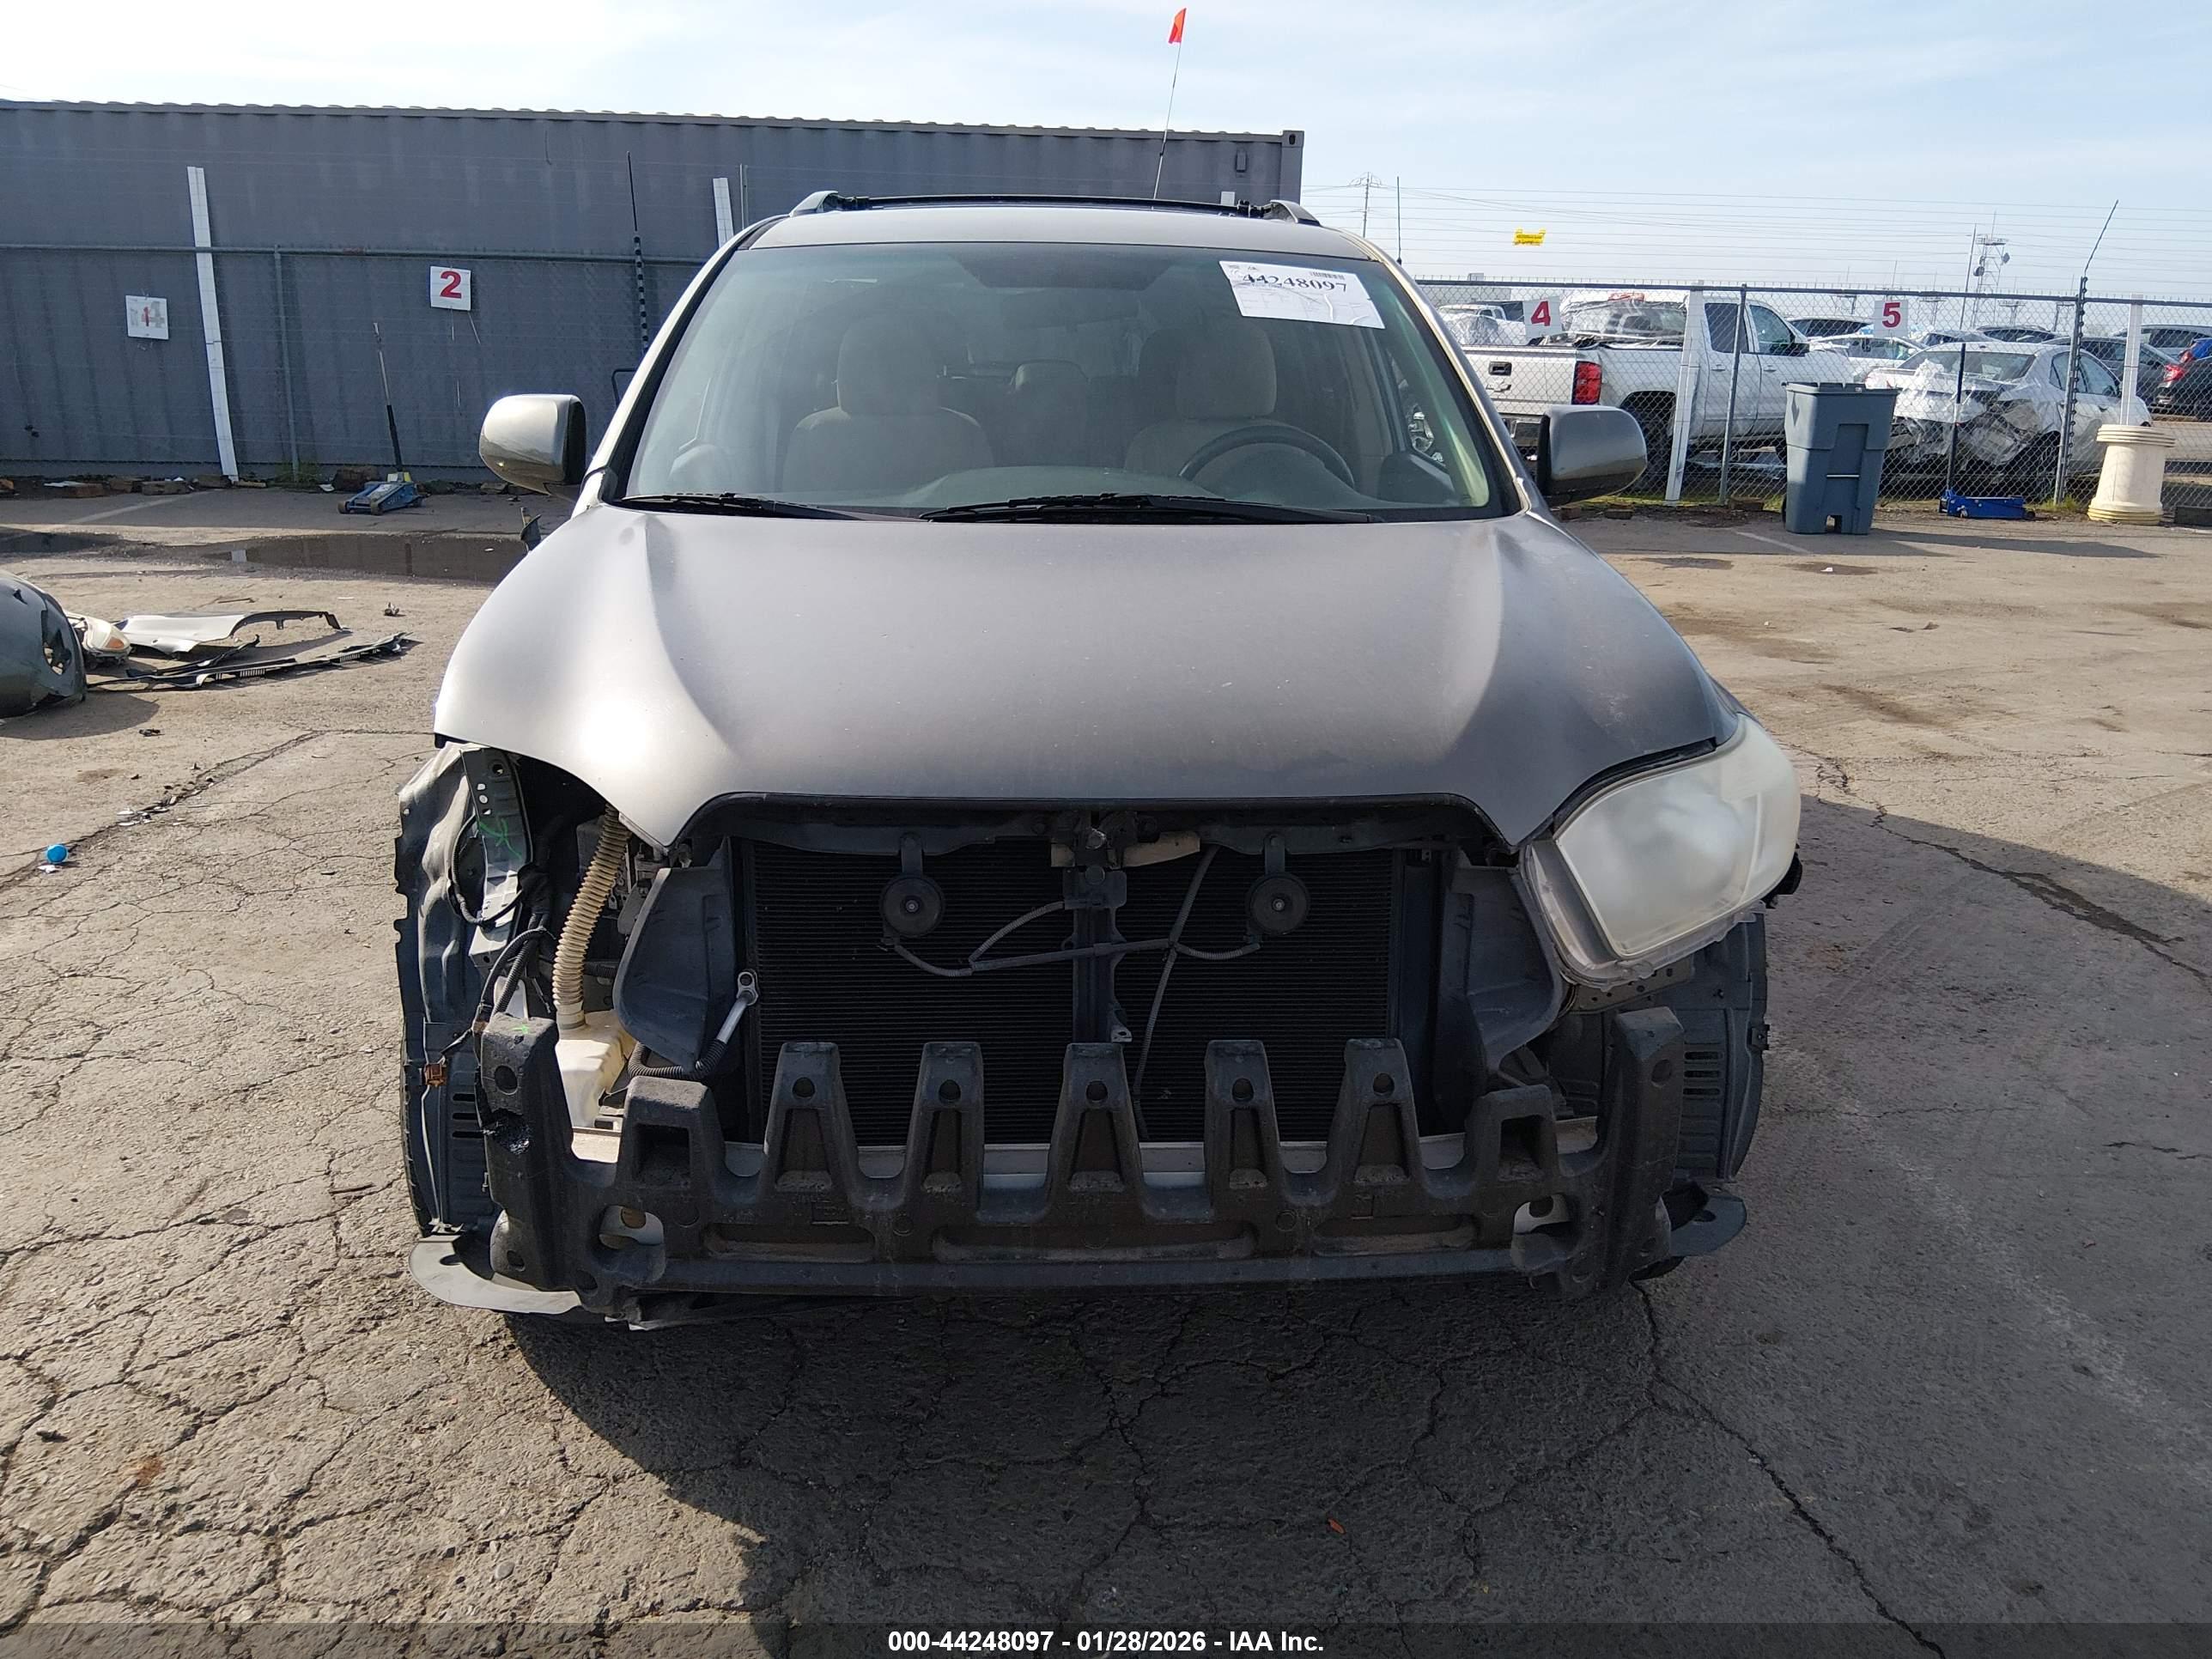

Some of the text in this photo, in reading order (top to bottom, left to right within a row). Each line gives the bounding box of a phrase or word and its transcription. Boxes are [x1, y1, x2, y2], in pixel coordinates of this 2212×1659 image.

[440, 270, 462, 299] 2
[1243, 274, 1346, 292] 44248097
[1530, 301, 1551, 327] 4
[1882, 301, 1901, 328] 5
